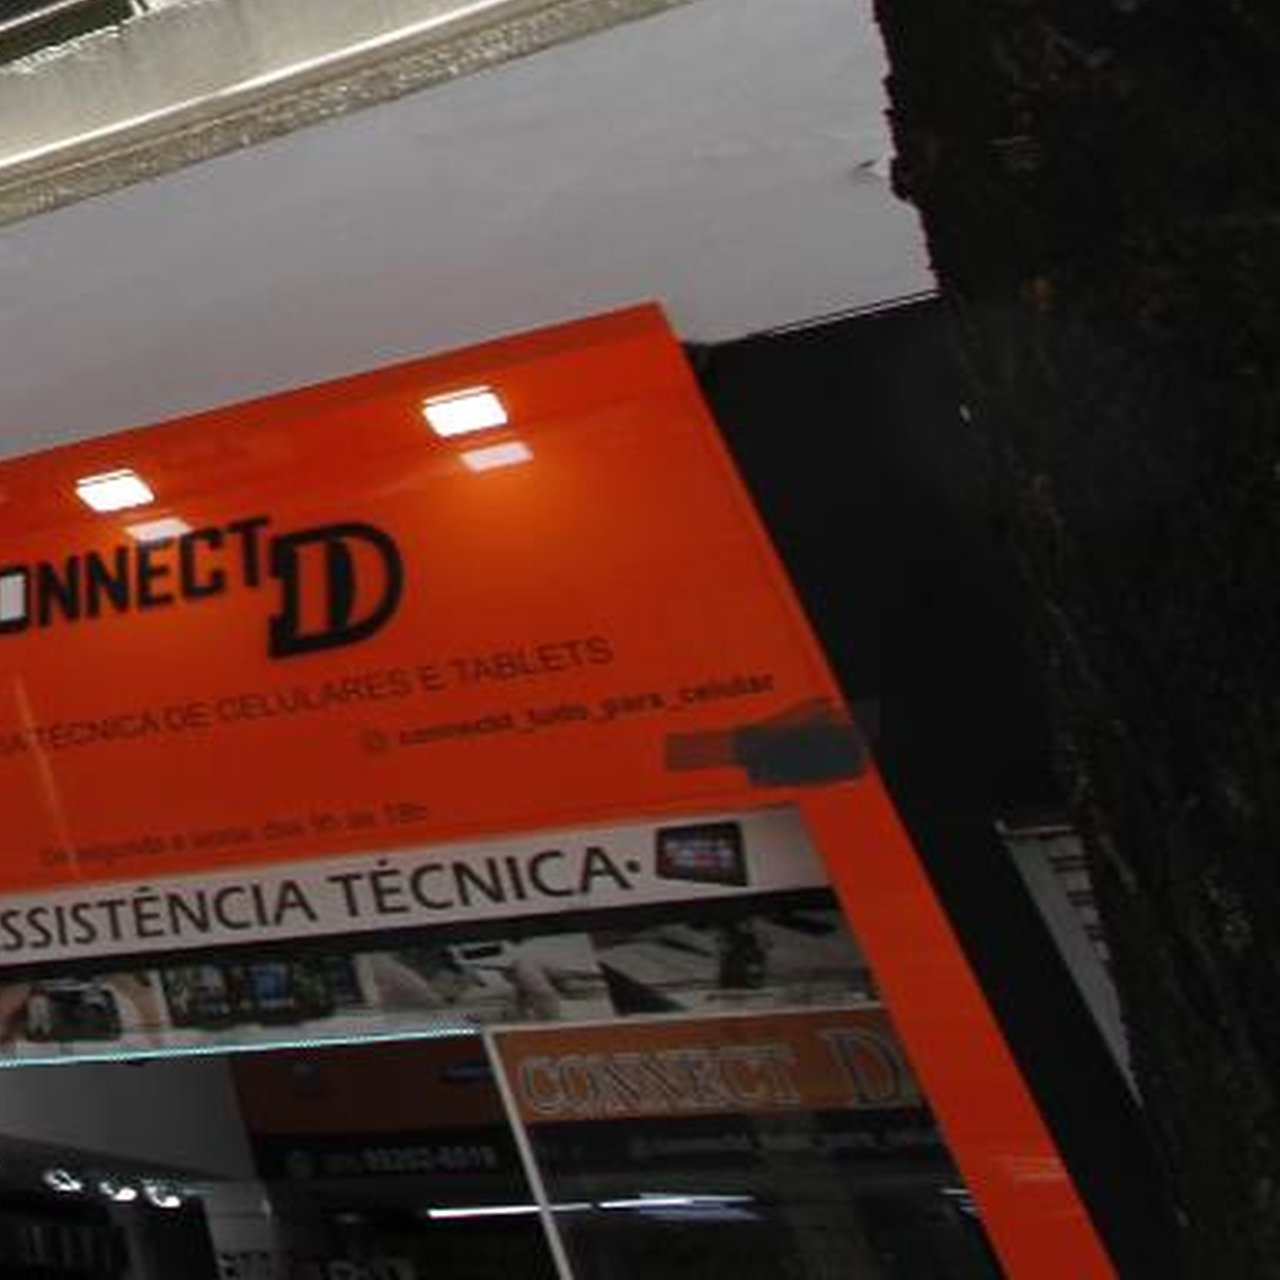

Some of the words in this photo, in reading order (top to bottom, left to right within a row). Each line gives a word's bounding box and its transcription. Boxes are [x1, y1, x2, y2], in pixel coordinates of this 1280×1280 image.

[168, 701, 213, 732] DE
[215, 665, 410, 723] CELULARES
[422, 664, 447, 692] E
[450, 635, 615, 684] TABLETS
[520, 1043, 803, 1118] CONNECT
